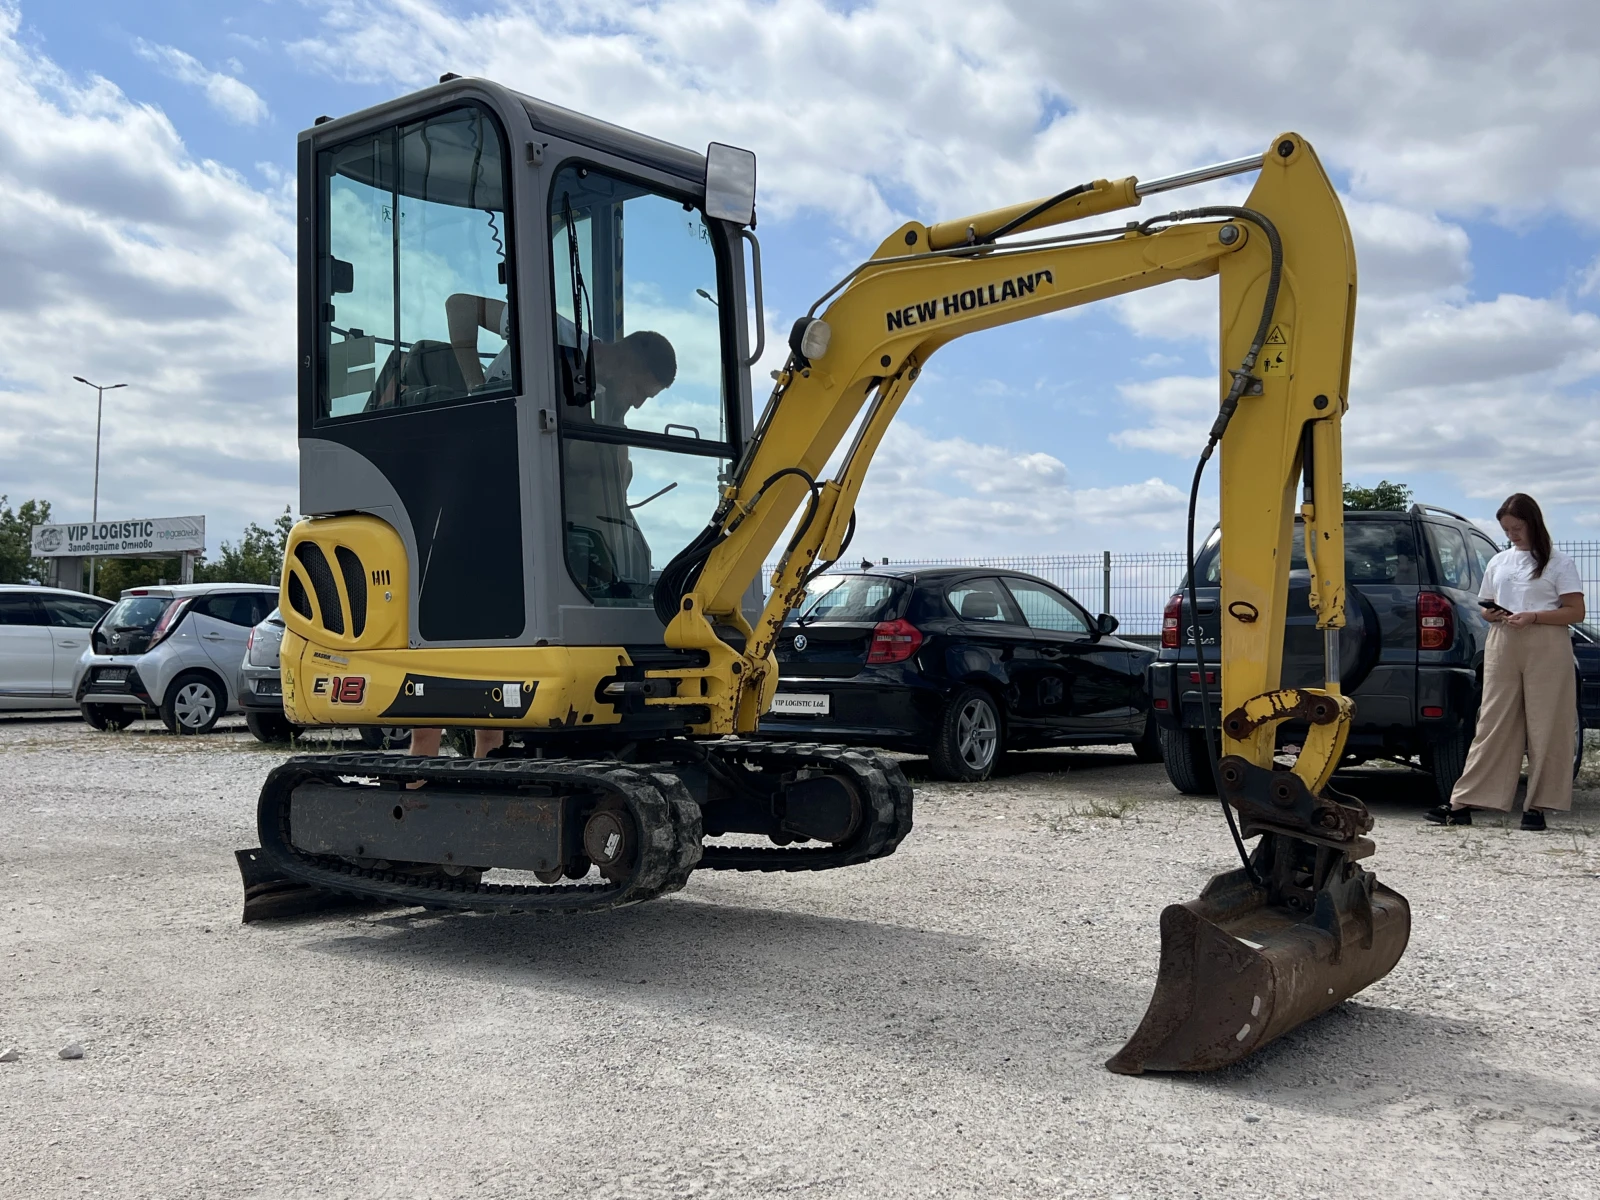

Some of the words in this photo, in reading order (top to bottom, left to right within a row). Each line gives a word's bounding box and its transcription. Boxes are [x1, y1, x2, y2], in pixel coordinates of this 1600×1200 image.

[886, 299, 937, 332] NEW
[67, 525, 89, 542] VIP
[91, 521, 154, 541] LOGISTIC
[68, 541, 120, 553] Заповядайте
[121, 540, 153, 549] Отново
[775, 699, 785, 707] VIP
[813, 700, 825, 708] Ltd.
